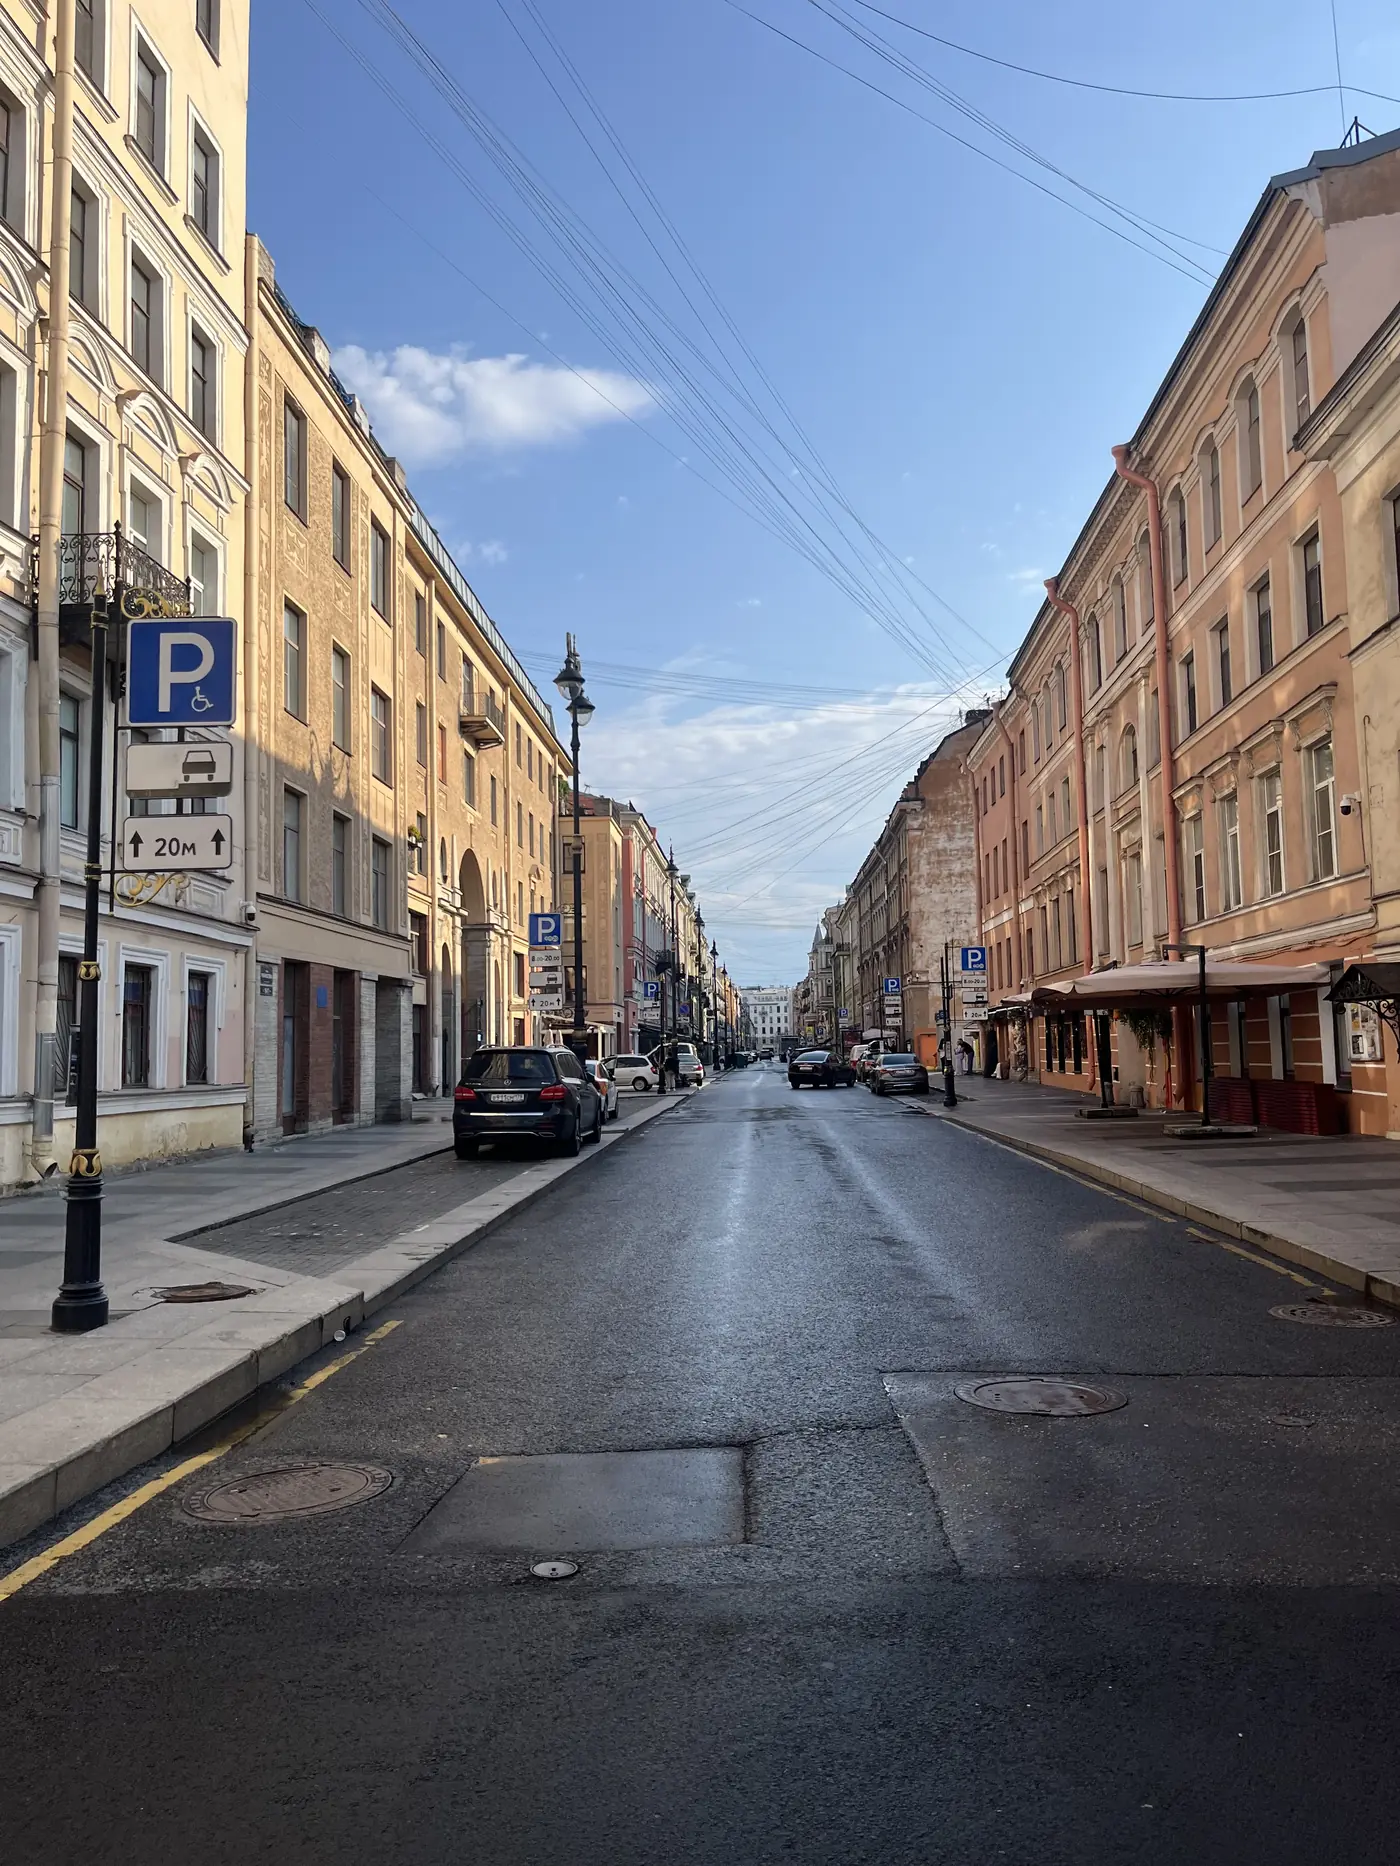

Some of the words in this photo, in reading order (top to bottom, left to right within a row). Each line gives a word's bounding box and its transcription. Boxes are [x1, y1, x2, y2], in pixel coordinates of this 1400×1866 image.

[158, 632, 215, 712] P
[154, 837, 197, 857] 20м
[538, 917, 556, 942] P
[967, 950, 982, 969] P
[648, 983, 657, 997] P
[888, 980, 898, 992] P
